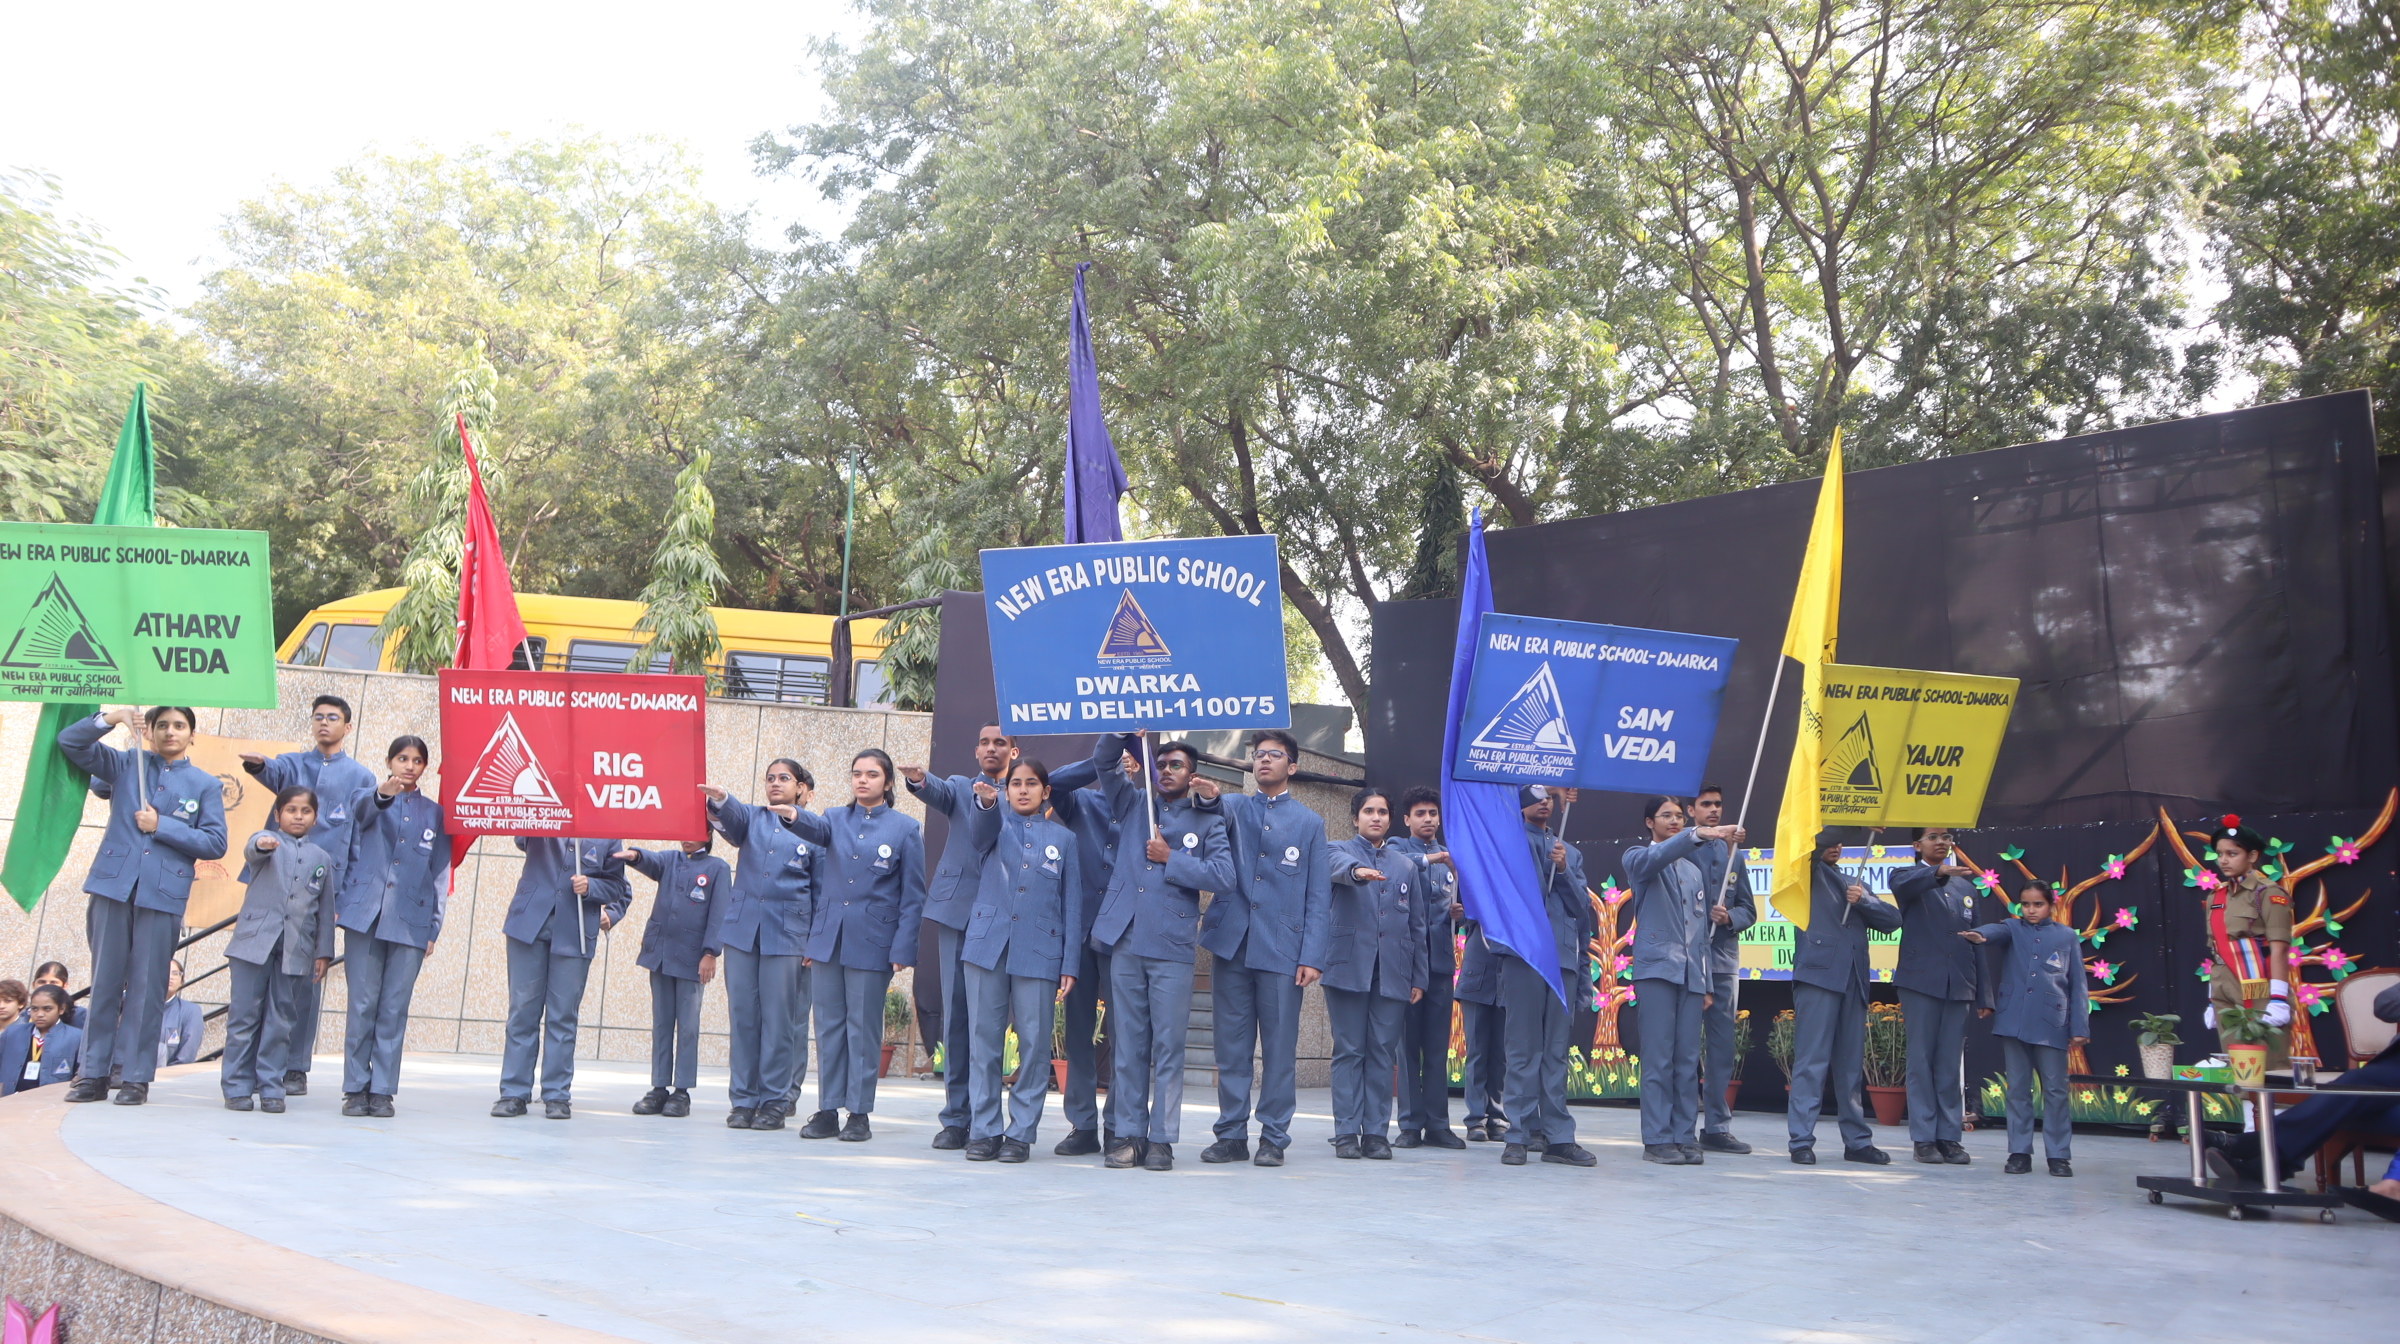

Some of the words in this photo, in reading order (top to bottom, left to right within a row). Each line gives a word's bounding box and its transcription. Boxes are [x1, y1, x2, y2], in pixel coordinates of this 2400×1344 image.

[28, 544, 55, 561] ERA
[61, 545, 110, 563] PUBLIC
[116, 547, 250, 566] SCHOOL-DWARKA
[995, 573, 1046, 622] NEW
[1045, 562, 1091, 597] ERA
[1093, 556, 1170, 586] PUBLIC
[1177, 557, 1267, 607] SCHOOL
[133, 613, 241, 639] ATHARV
[152, 646, 230, 674] VEDA
[1489, 633, 1520, 651] NEW
[1525, 636, 1549, 655] ERA
[1553, 639, 1596, 660] PUBLIC
[1598, 644, 1718, 672] SCHOOL-DWARKA
[1, 670, 25, 681] NEW
[29, 672, 47, 682] ERA
[50, 673, 82, 683] PUBLIC
[86, 674, 122, 685] SCHOOL
[1075, 673, 1201, 696] DWARKA
[451, 687, 482, 704] NEW
[489, 688, 514, 706] ERA
[518, 689, 565, 707] PUBLIC
[570, 691, 698, 711] SCHOOL-DWARKA
[1824, 684, 1854, 699] NEW
[1857, 685, 1878, 700] ERA
[1881, 686, 1922, 702] PUBLIC
[1923, 688, 2010, 706] SCHOOL-DWARKA
[1010, 702, 1072, 723] NEW
[1081, 696, 1276, 720] DELHI-110075
[1617, 705, 1675, 732] SAM
[1469, 748, 1489, 760] NEW
[1491, 750, 1506, 762] ERA
[1509, 752, 1539, 764] PUBLIC
[1541, 755, 1574, 766] SCHOOL
[1604, 734, 1676, 763] VEDA
[1906, 744, 1964, 768] YAJUR
[593, 751, 644, 778] RIG
[585, 783, 662, 810] VEDA
[1906, 774, 1953, 796] VEDA
[455, 804, 481, 816] NEW
[484, 805, 502, 817] ERA
[504, 806, 537, 817] PUBLIC
[538, 807, 573, 818] SCHOOL
[1827, 794, 1851, 803] PUBLIC
[1852, 795, 1878, 804] SCHOOL
[1760, 926, 1786, 941] ERA
